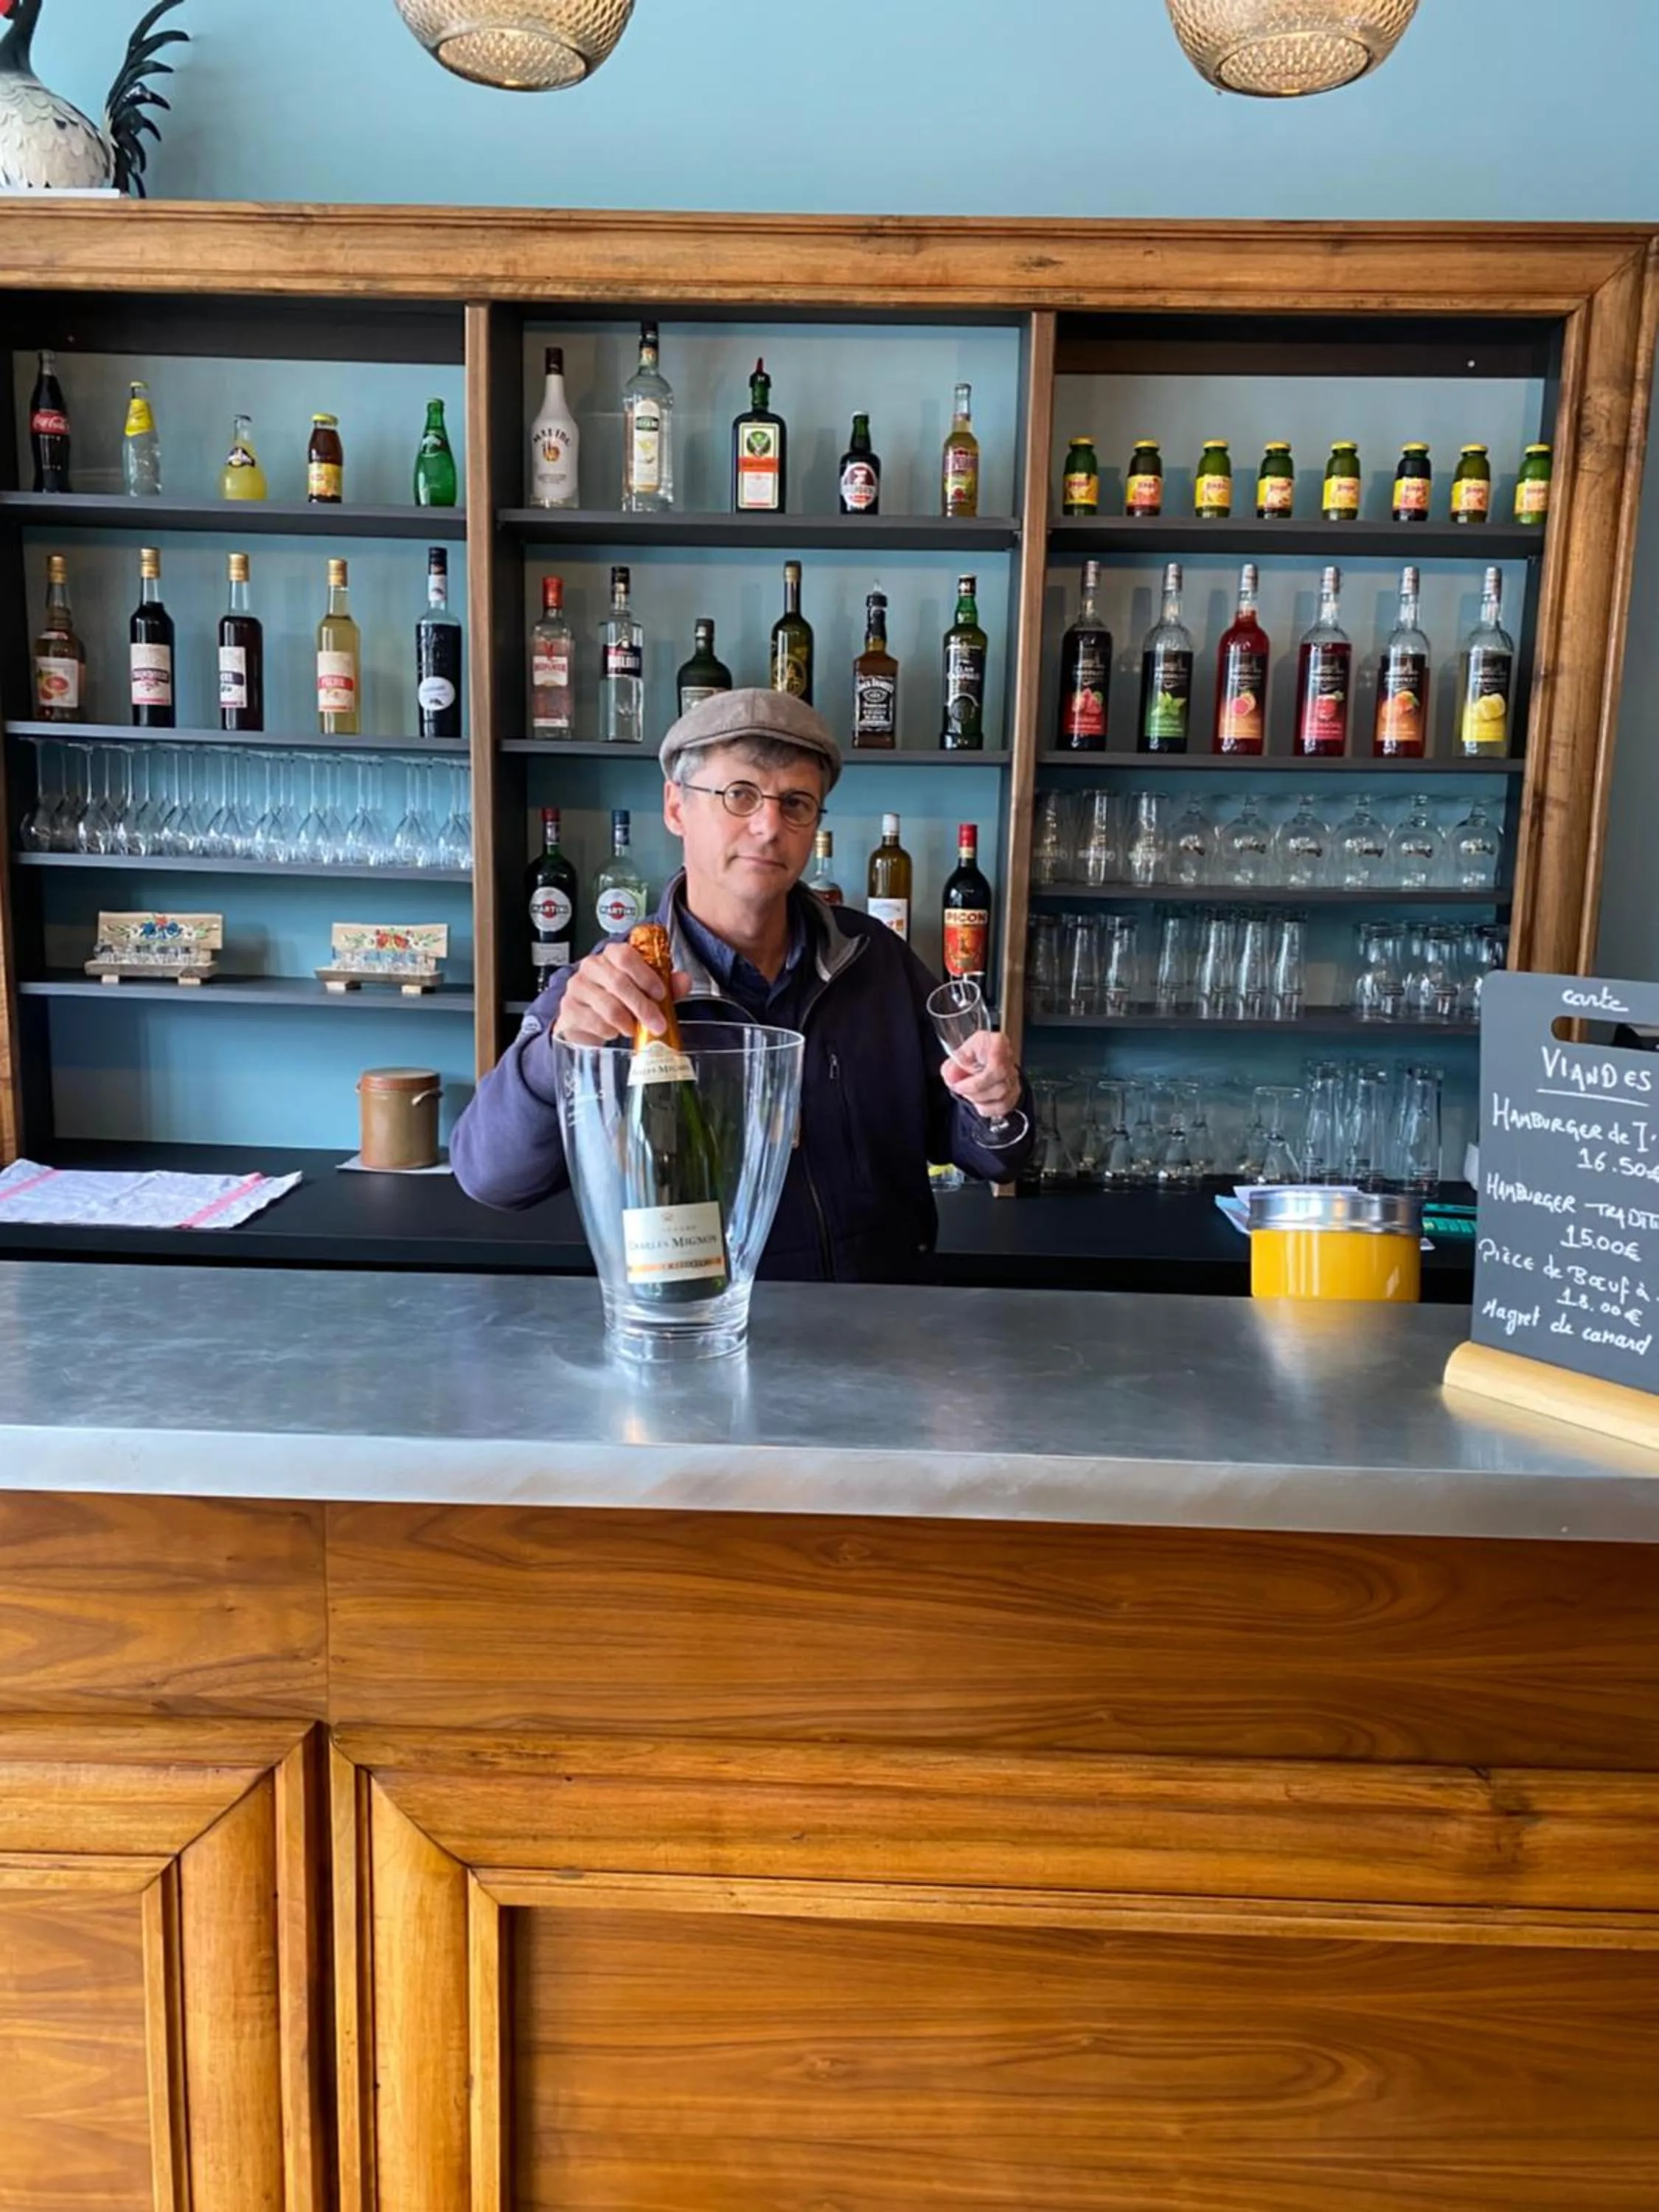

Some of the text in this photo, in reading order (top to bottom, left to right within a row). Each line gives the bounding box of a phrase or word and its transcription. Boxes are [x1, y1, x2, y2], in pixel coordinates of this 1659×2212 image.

[946, 912, 987, 922] PICON
[1541, 1045, 1652, 1091] VIANDES
[1607, 1121, 1631, 1145] de
[1559, 1224, 1642, 1262] 15.00€
[1543, 1253, 1563, 1279] de
[1550, 1312, 1575, 1335] de
